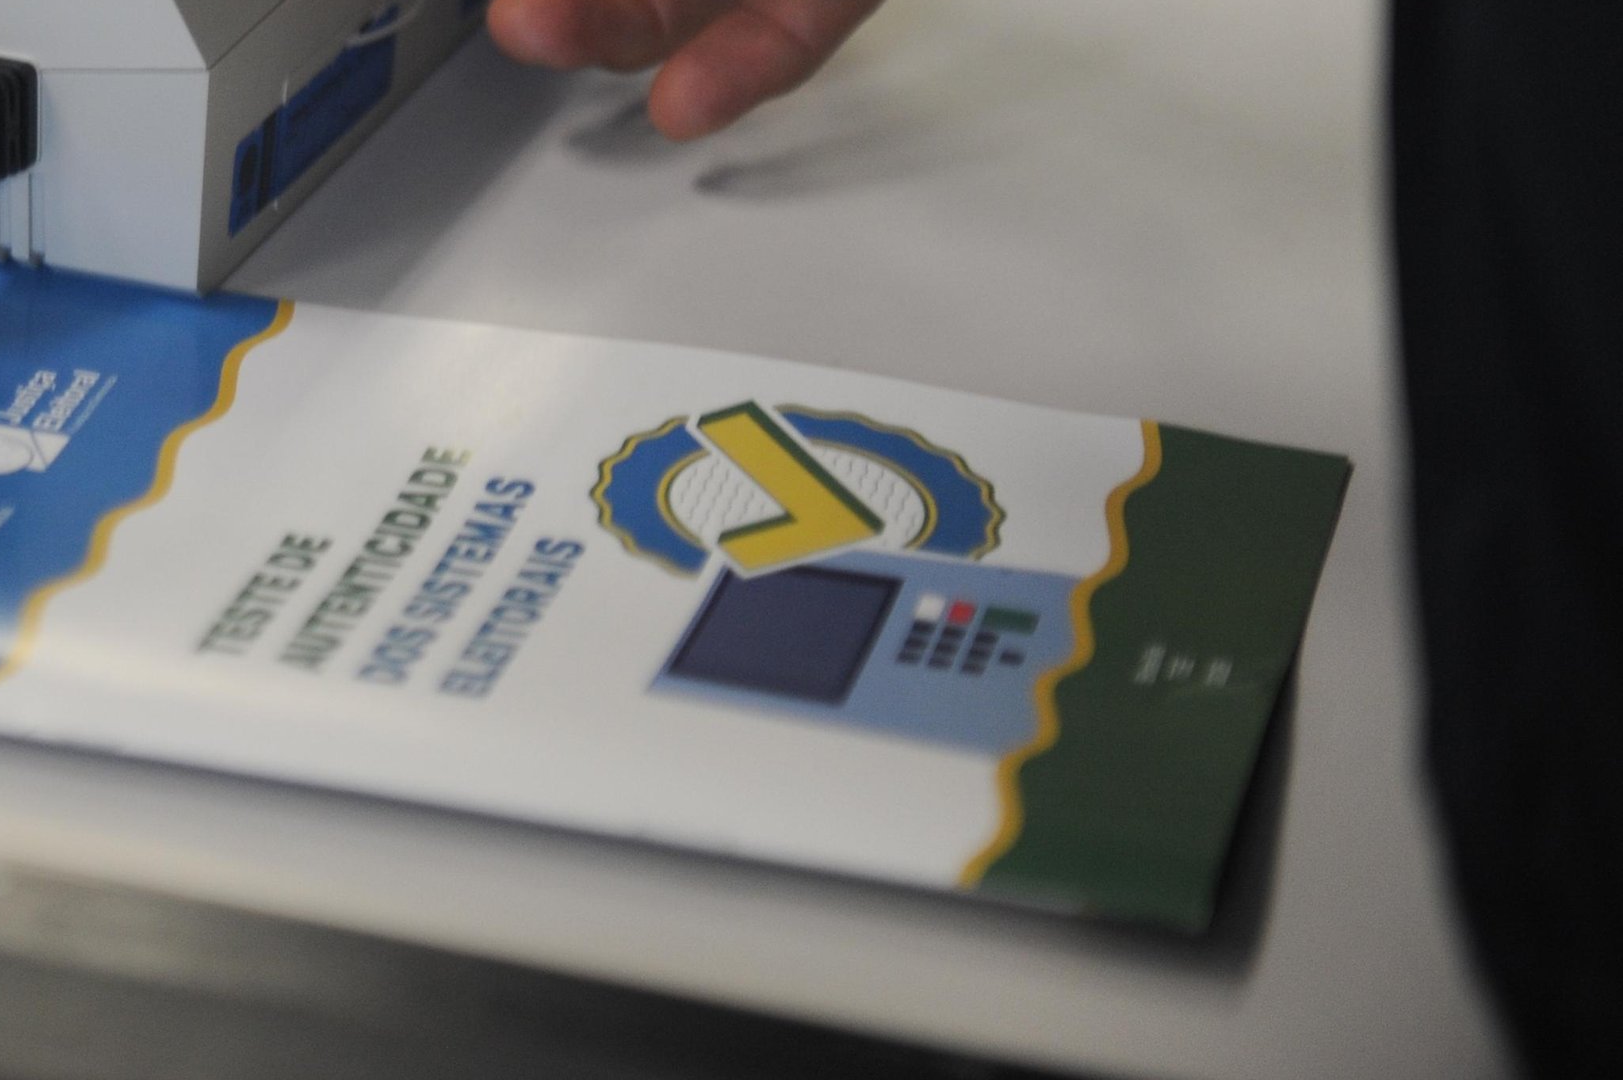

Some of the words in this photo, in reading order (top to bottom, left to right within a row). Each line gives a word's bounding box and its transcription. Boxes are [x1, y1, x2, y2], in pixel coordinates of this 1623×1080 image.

[194, 573, 290, 656] TESTE
[269, 534, 333, 583] DE
[279, 446, 472, 671] AUTENTICIDADE
[355, 625, 439, 688] DOS
[403, 476, 537, 623] SISTEMAS
[438, 537, 586, 700] ELEITORAIS
